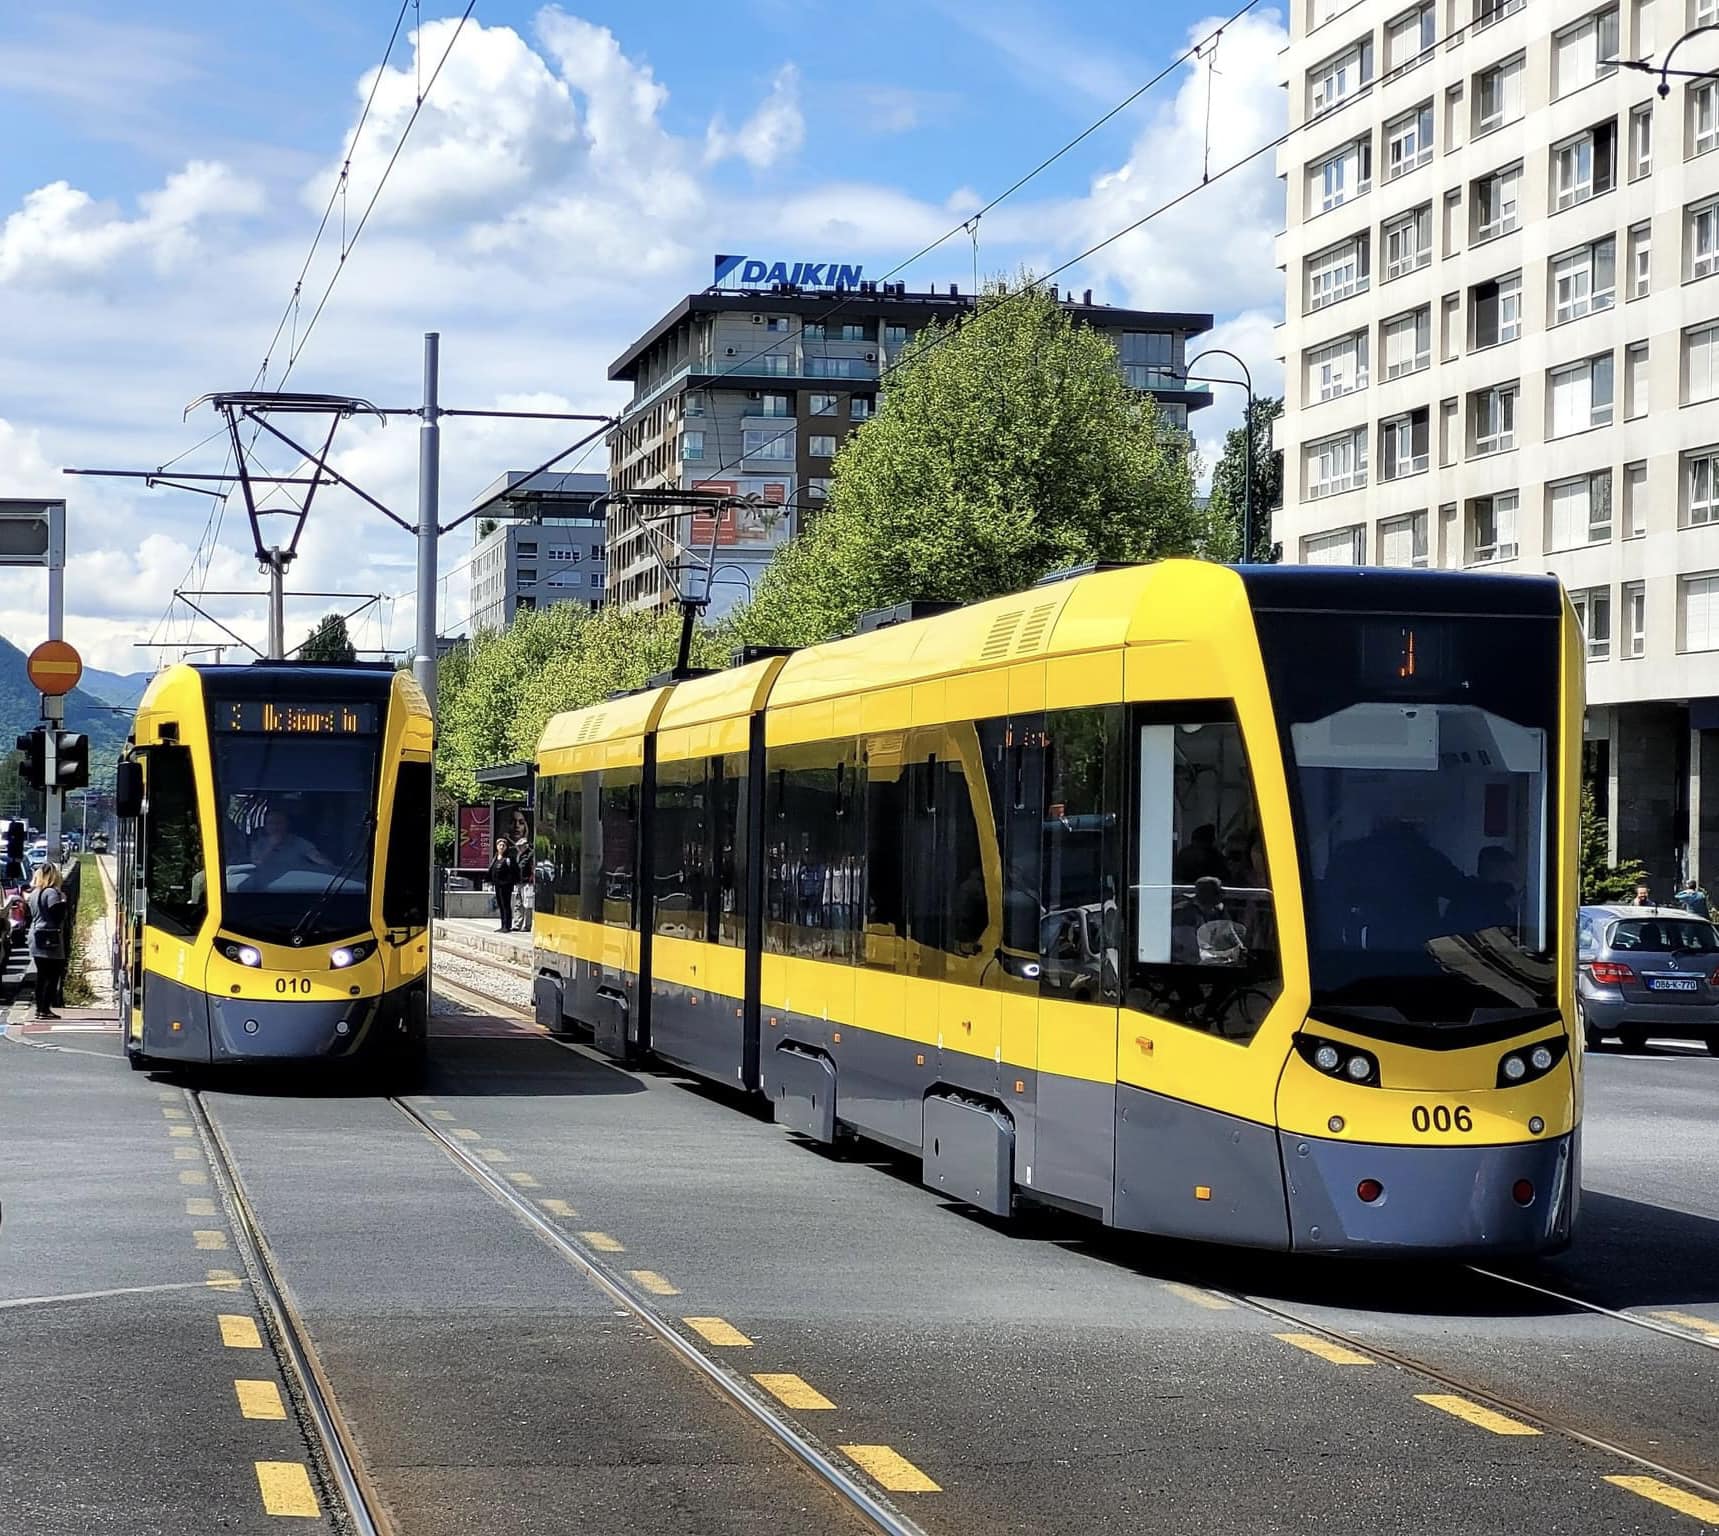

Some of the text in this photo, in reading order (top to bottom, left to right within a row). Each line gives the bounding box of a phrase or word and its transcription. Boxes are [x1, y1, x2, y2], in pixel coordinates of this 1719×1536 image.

[741, 261, 863, 287] DAIKIN
[275, 978, 311, 993] 010
[1412, 1105, 1473, 1132] 006
